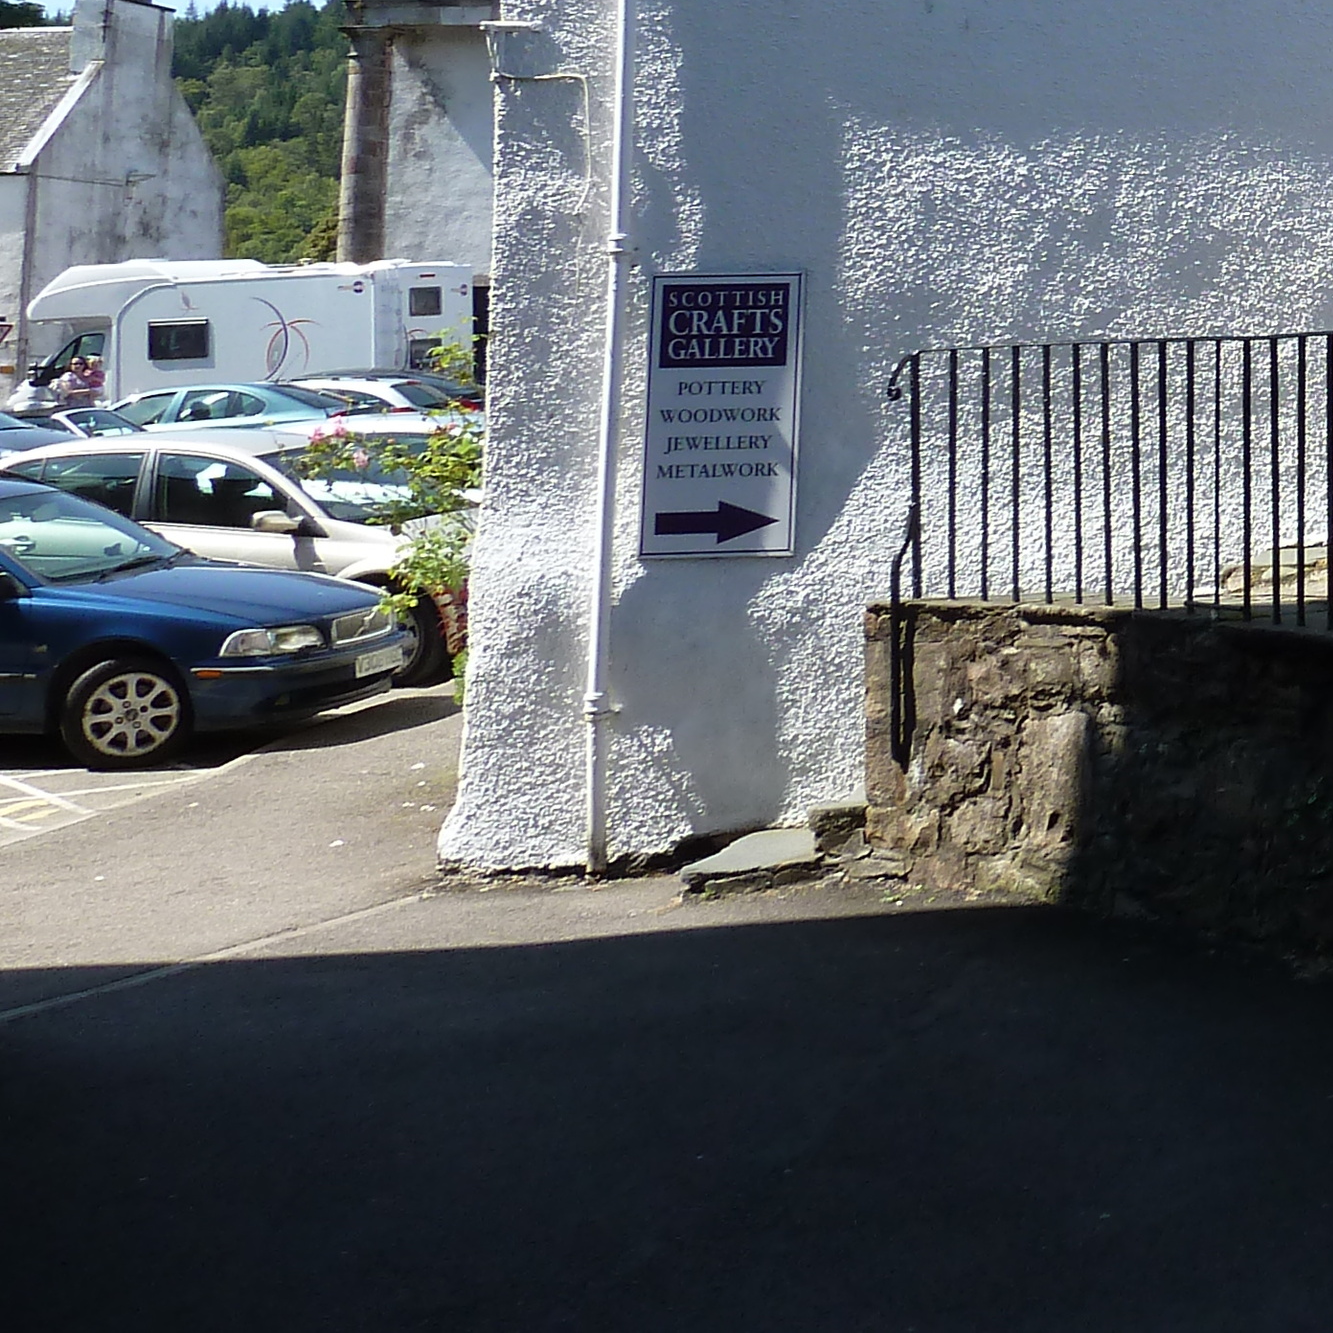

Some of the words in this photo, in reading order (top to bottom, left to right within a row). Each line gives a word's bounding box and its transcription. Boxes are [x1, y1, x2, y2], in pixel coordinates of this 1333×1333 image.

[668, 290, 785, 307] SCOTTISH
[668, 308, 783, 336] CRAFTS
[668, 337, 781, 360] GALLERY
[677, 380, 767, 396] POTTERY
[659, 407, 782, 424] WOODWORK
[663, 435, 773, 455] JEWELLERY
[656, 462, 779, 479] METALWORK
